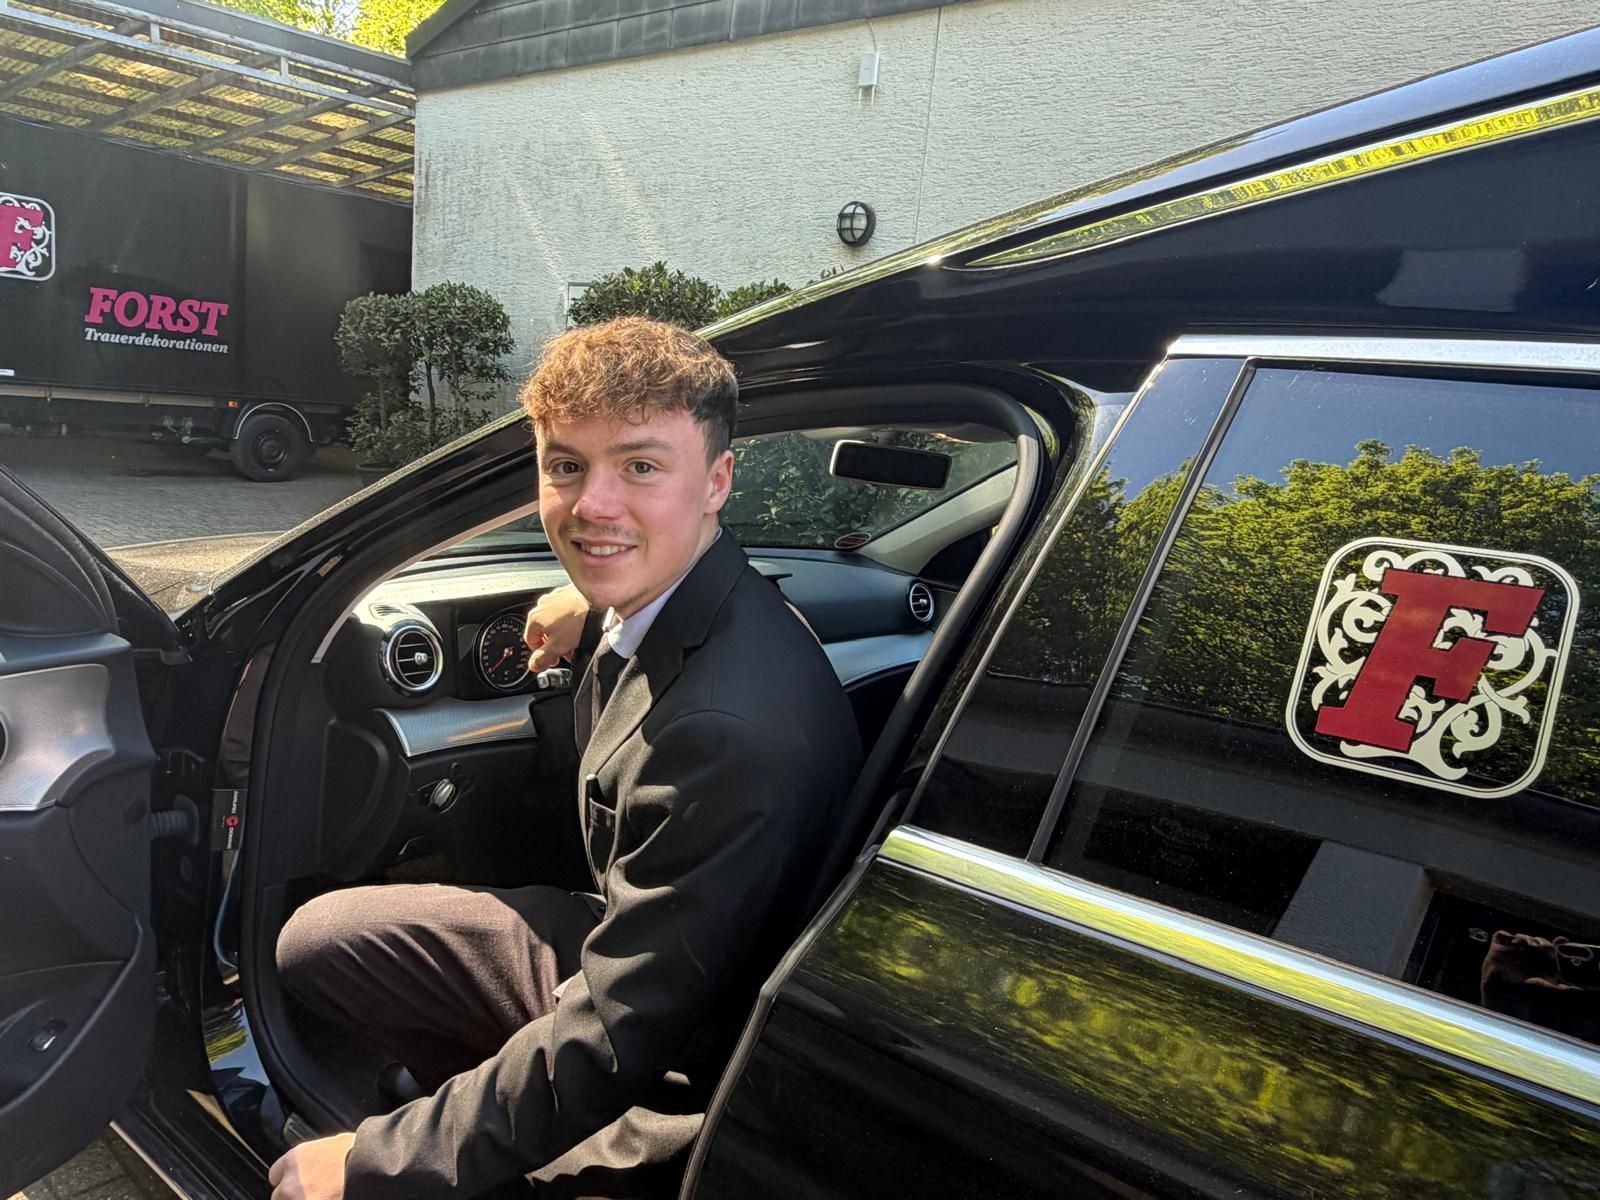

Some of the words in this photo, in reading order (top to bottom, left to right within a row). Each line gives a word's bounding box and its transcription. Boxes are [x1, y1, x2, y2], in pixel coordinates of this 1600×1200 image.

[84, 287, 229, 336] FORST
[84, 327, 229, 353] Trauerdekorationen
[1314, 568, 1546, 754] F
